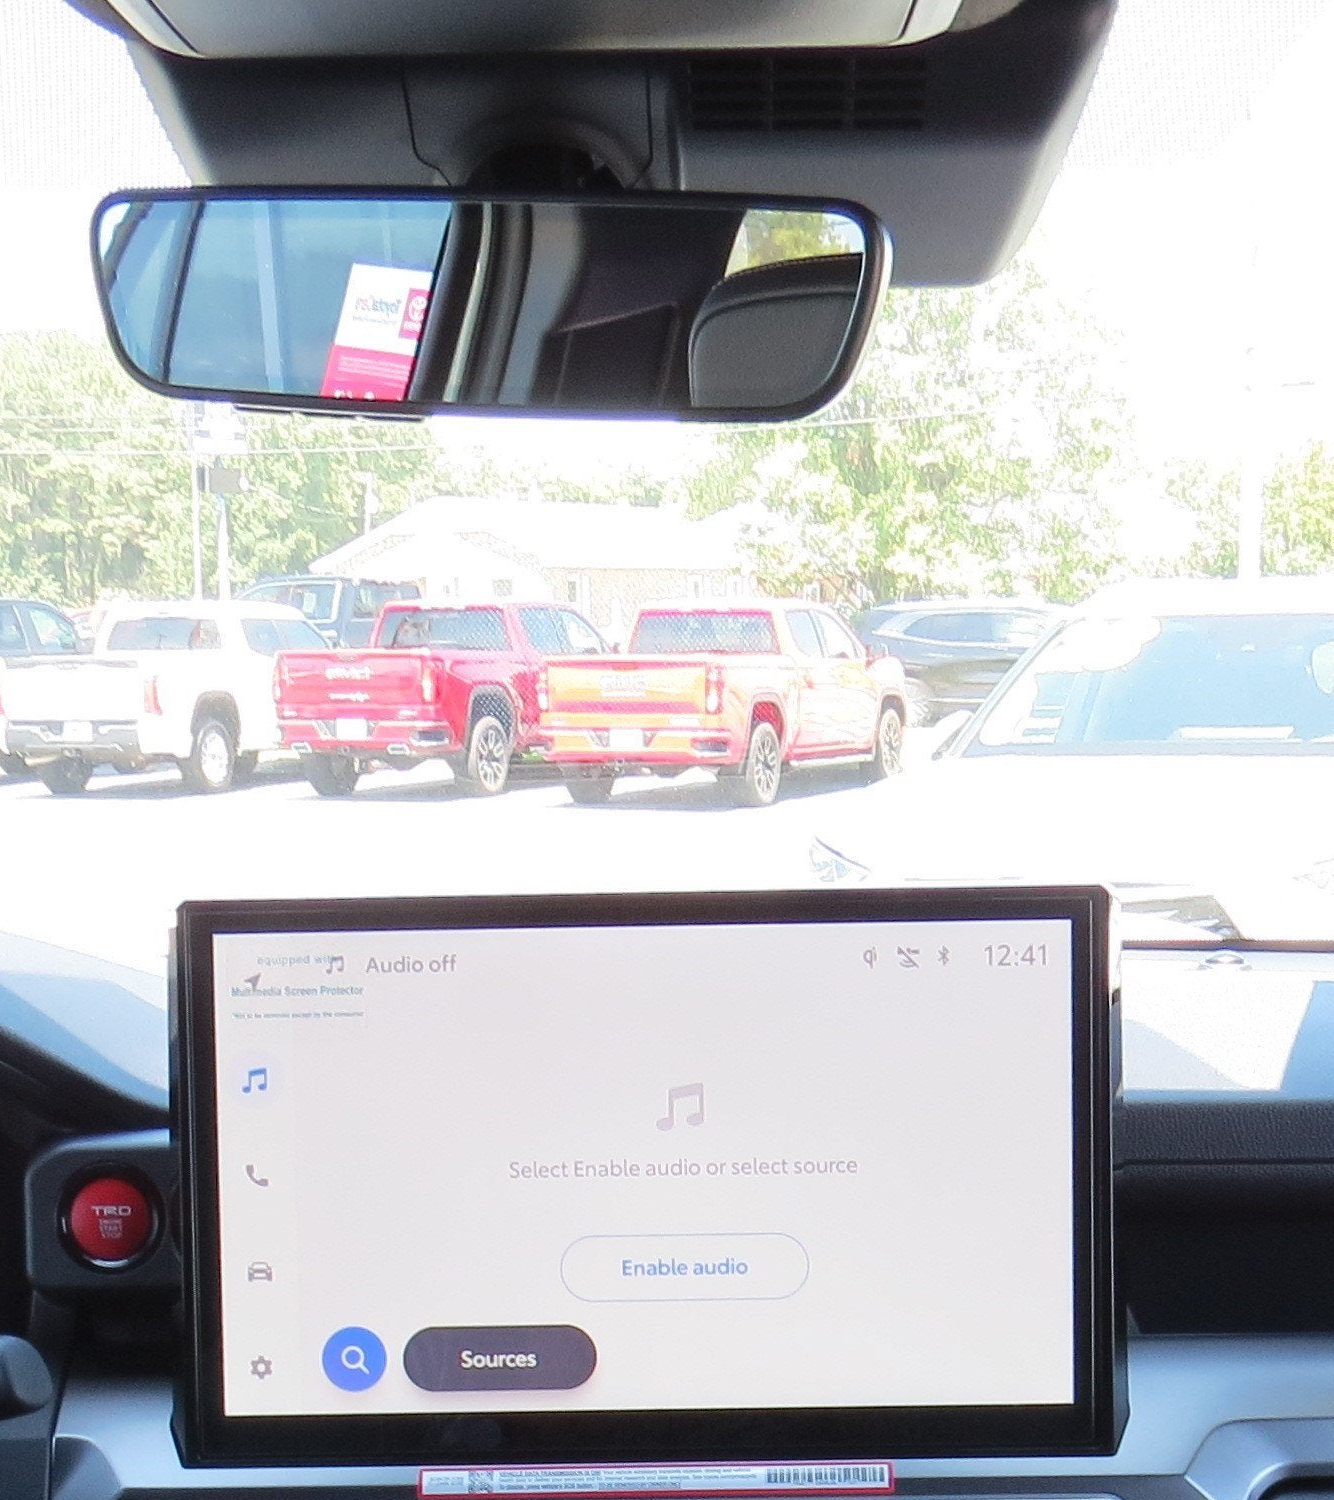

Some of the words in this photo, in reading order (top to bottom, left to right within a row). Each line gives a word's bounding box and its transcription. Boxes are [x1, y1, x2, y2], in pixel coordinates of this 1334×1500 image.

[366, 956, 424, 974] Audio
[429, 955, 457, 973] off
[984, 944, 1049, 967] 12:41
[284, 985, 317, 996] Screen
[320, 985, 364, 996] Protector
[509, 1161, 568, 1180] Select
[573, 1160, 641, 1179] Enable
[646, 1157, 701, 1177] audio
[706, 1161, 727, 1177] or
[731, 1157, 788, 1176] select
[793, 1158, 858, 1175] source
[91, 1205, 132, 1216] TRD
[621, 1258, 689, 1277] Enable
[693, 1258, 749, 1277] audio
[460, 1349, 538, 1370] Sources
